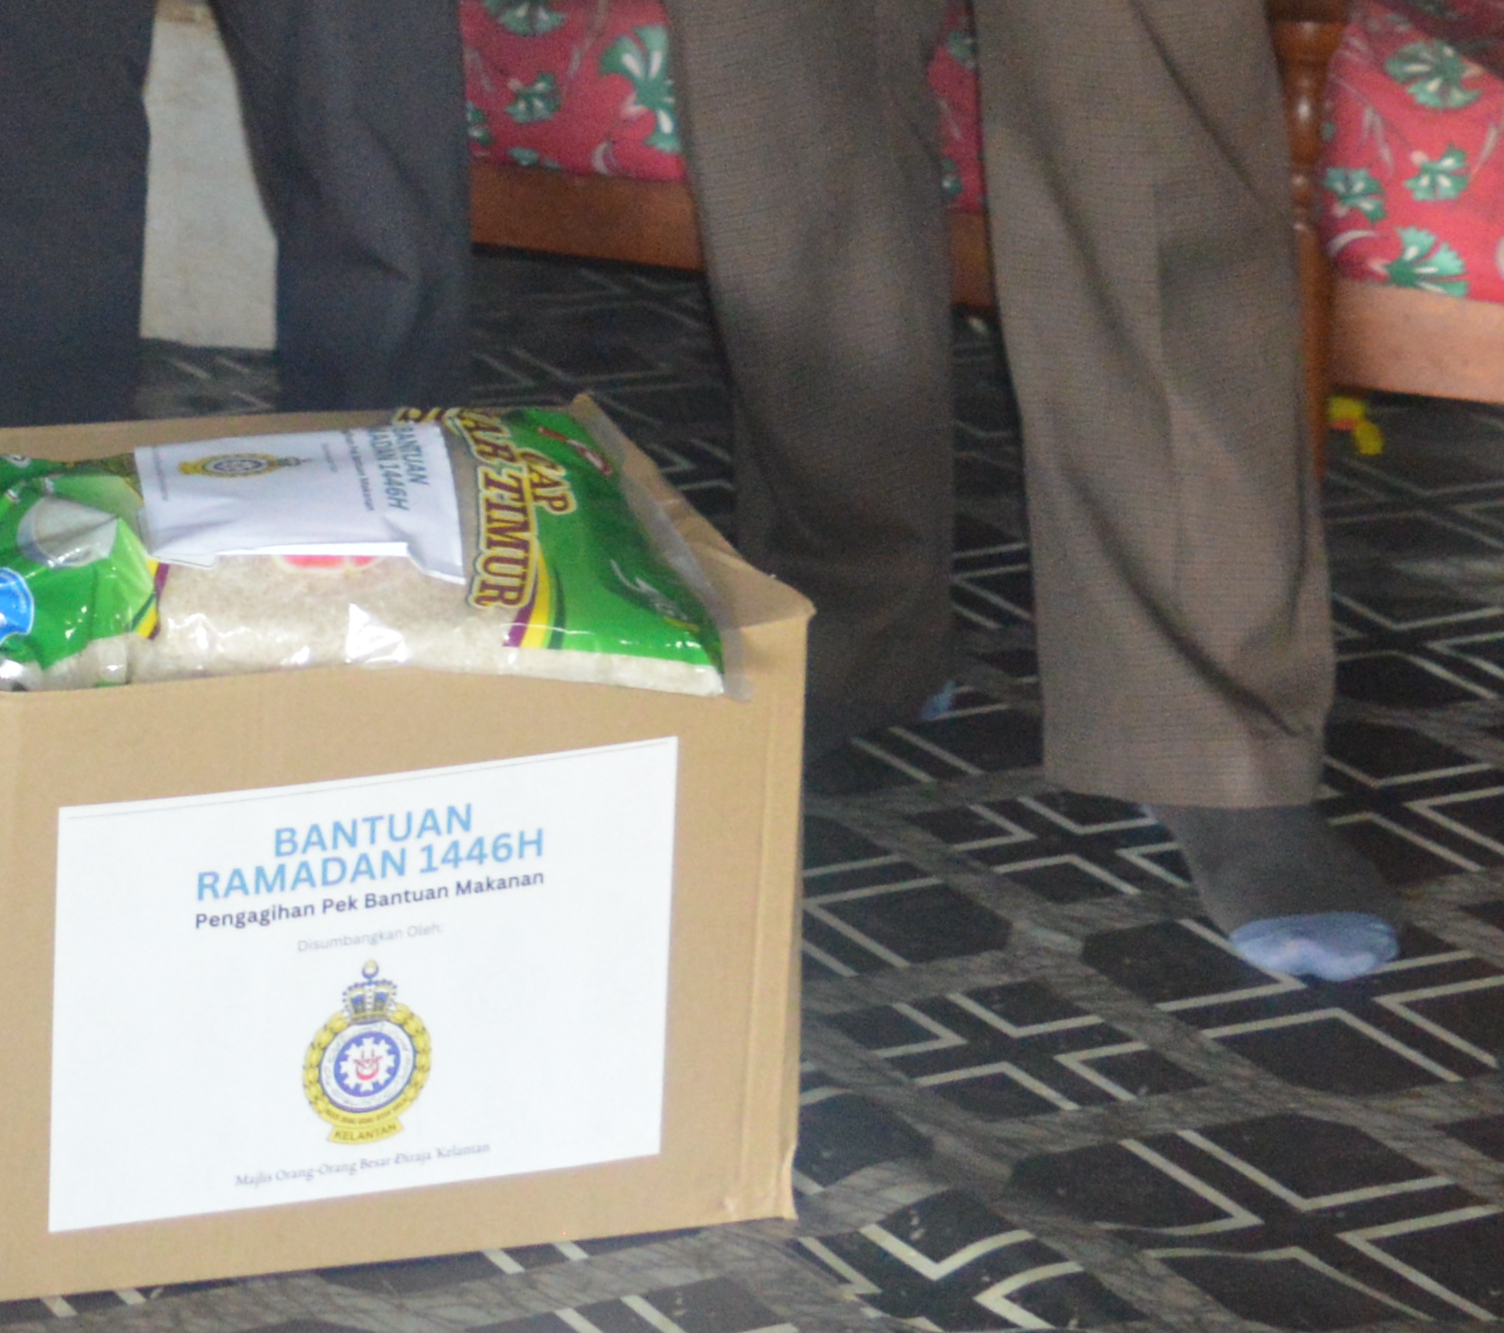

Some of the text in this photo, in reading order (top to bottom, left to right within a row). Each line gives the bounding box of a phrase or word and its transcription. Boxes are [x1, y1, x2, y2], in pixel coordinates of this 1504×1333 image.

[378, 463, 410, 511] 1446H
[519, 450, 570, 514] CAP
[472, 467, 534, 608] TIMUR
[274, 802, 474, 858] BANTUAN
[196, 828, 545, 902] RAMADAN 1446H
[195, 872, 545, 930] Pengagihan Pek Bantuan Makanan
[297, 927, 404, 953] Disumbangkan
[334, 1123, 397, 1141] KELANTAN
[234, 1174, 273, 1188] Majlis
[360, 1156, 392, 1170] Besar
[436, 1142, 491, 1159] Kelantan
